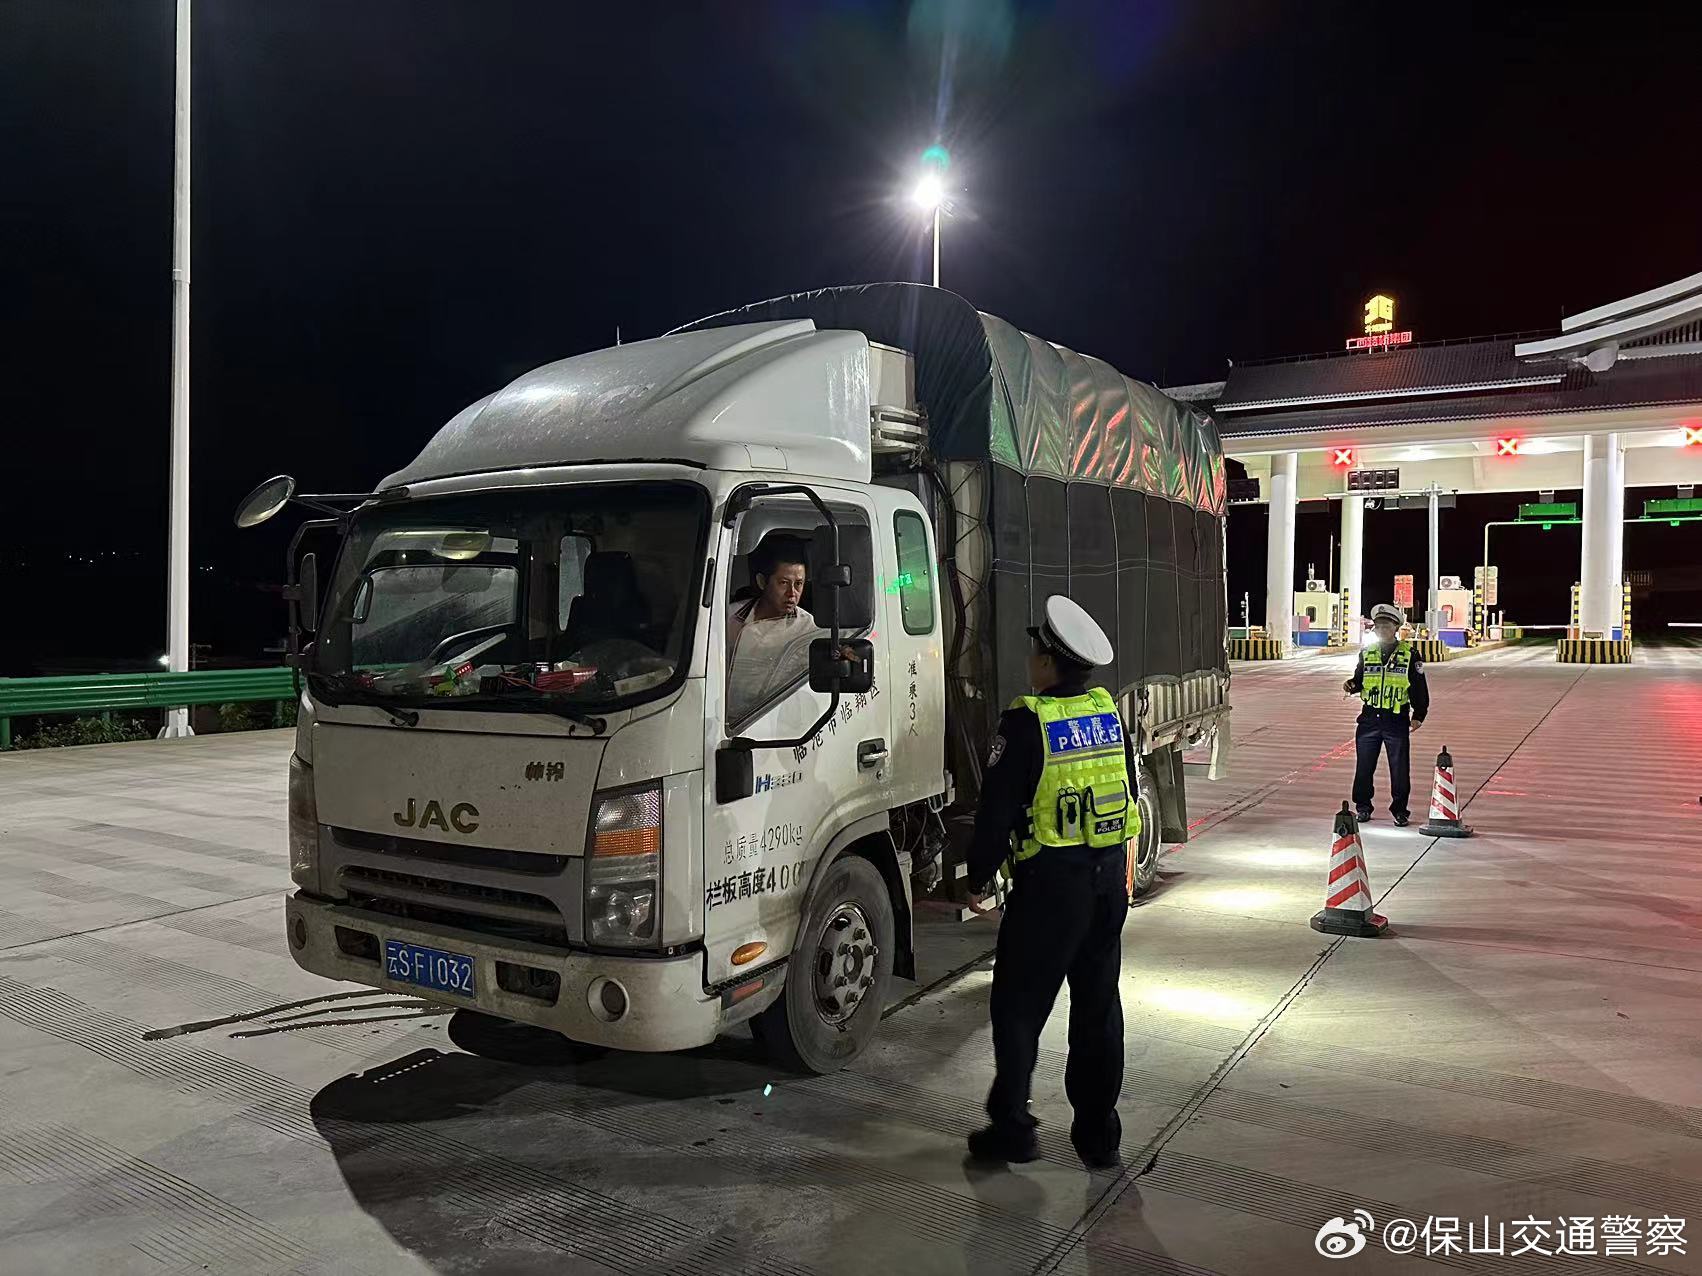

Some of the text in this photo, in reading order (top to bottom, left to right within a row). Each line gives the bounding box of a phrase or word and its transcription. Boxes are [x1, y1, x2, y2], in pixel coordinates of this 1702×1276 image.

[908, 660, 918, 736] 准乘3人
[394, 798, 480, 833] JAC
